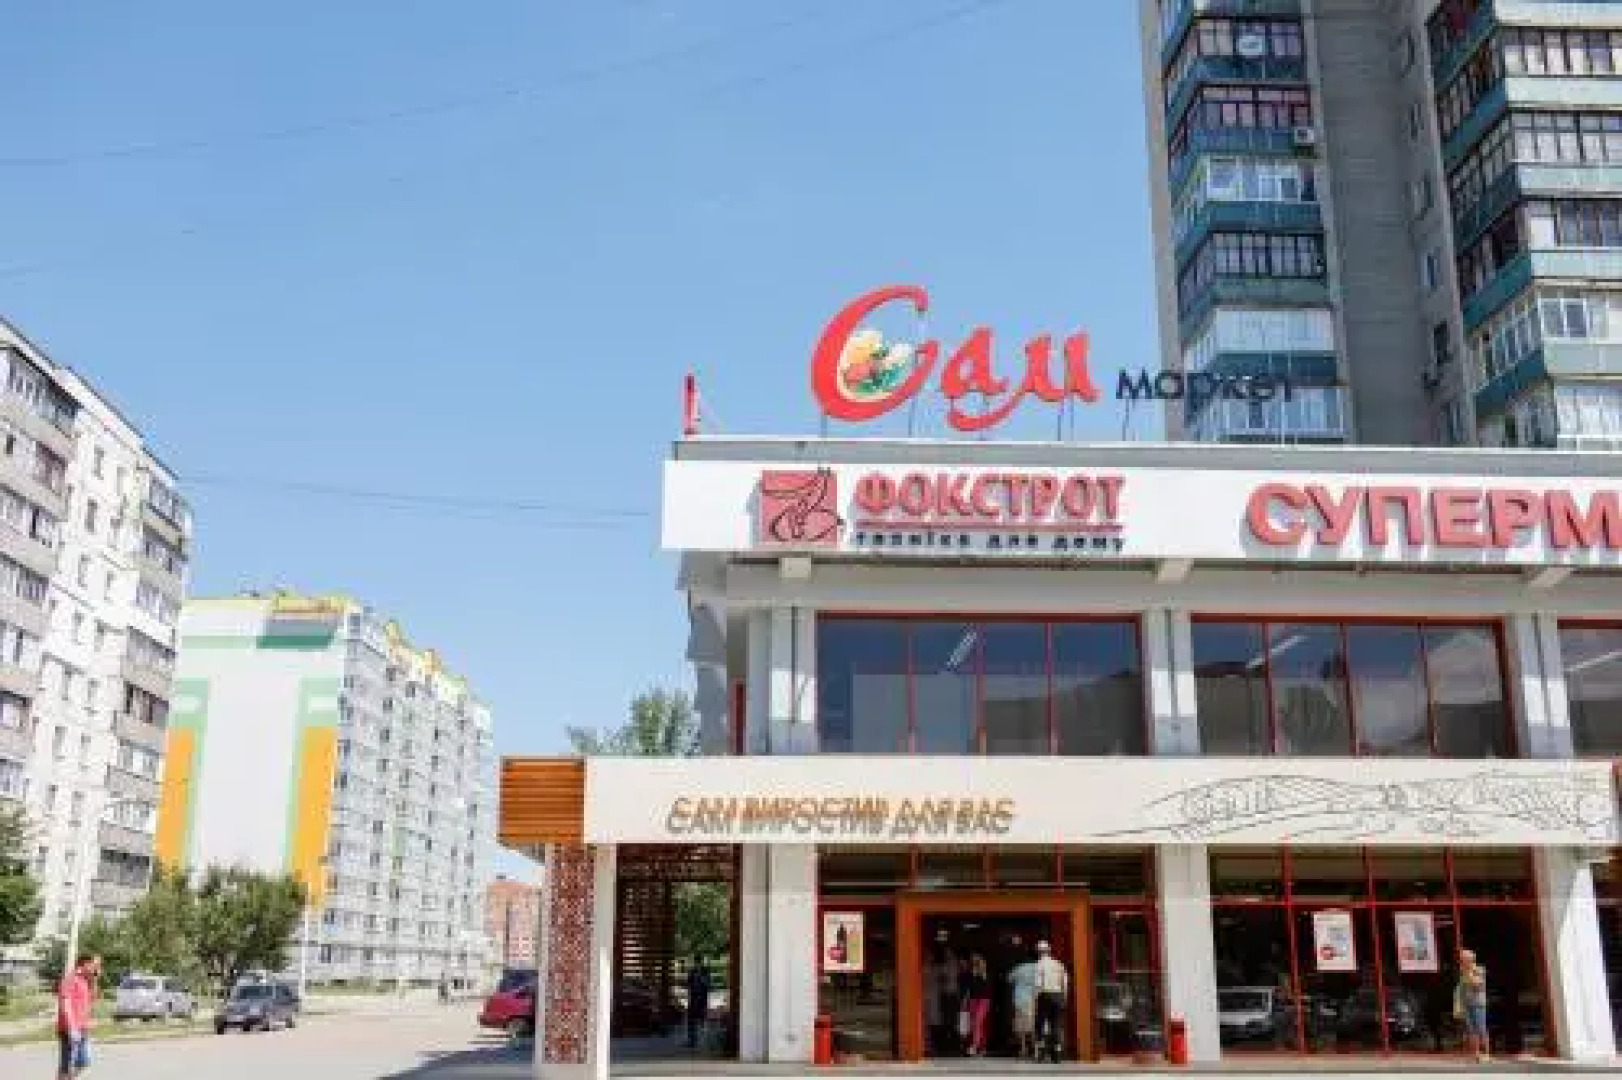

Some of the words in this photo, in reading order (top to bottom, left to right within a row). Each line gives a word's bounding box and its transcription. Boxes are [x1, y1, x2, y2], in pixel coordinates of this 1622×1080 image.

[854, 473, 1126, 520] ФОКСТРОТ
[1246, 481, 1622, 549] СУПЕРМ
[986, 533, 1038, 549] для
